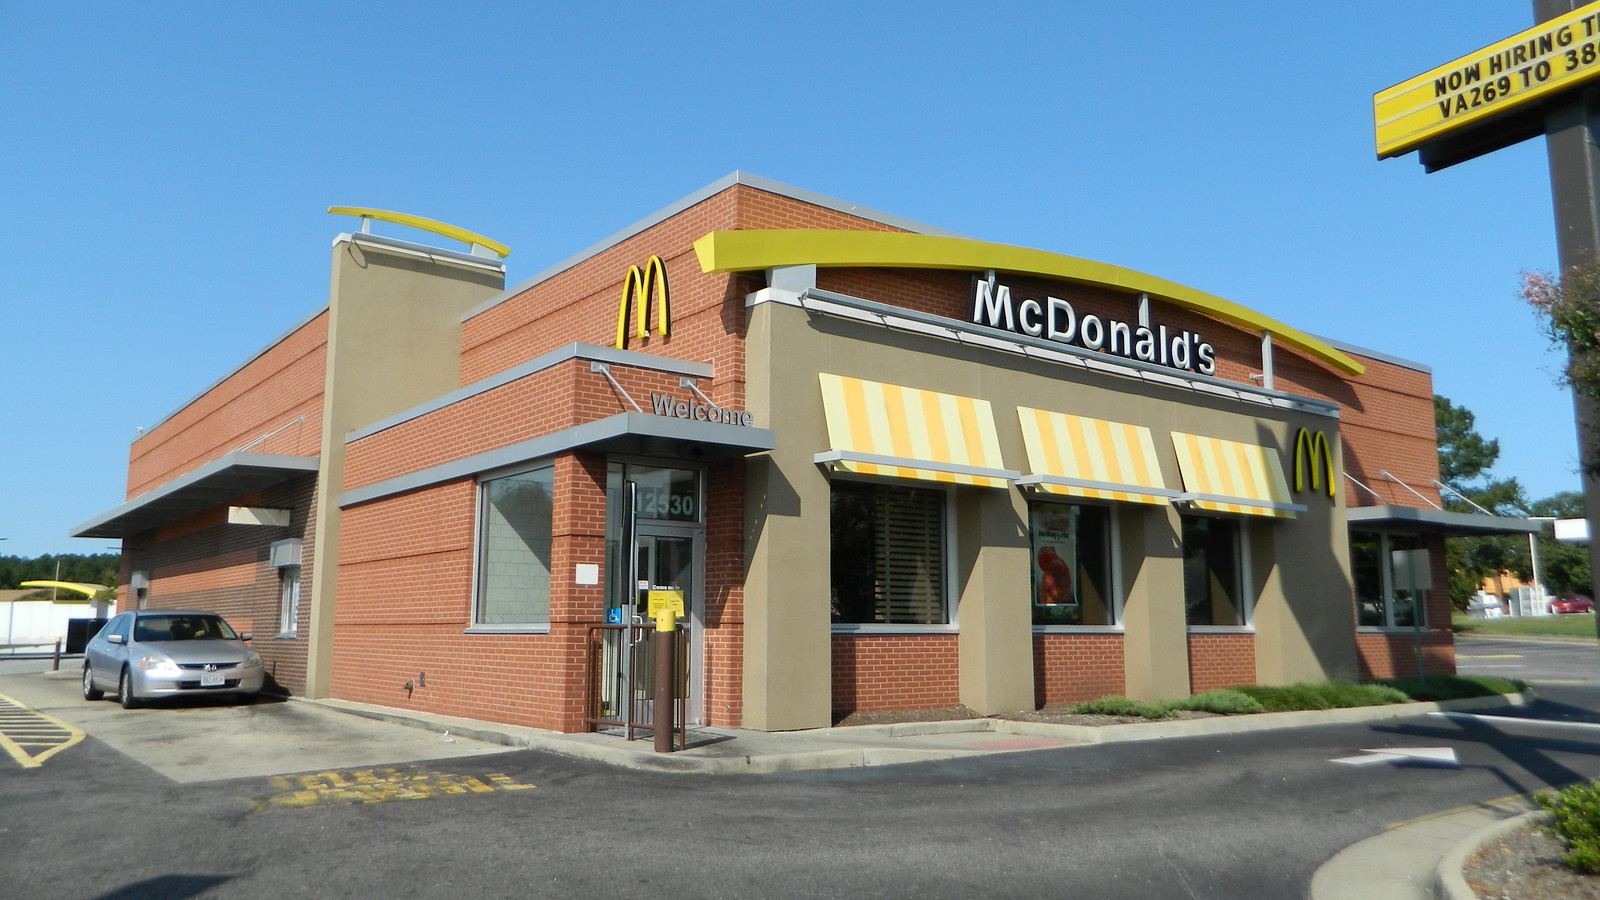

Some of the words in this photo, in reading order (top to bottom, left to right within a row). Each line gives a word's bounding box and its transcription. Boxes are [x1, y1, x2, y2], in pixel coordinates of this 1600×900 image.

[1435, 63, 1480, 97] NOW
[1489, 26, 1572, 75] HIRING
[1581, 12, 1600, 37] T
[1439, 75, 1511, 118] VA269
[1519, 61, 1551, 87] TO
[1565, 41, 1600, 72] 38
[972, 278, 1216, 376] McDonald's
[651, 393, 754, 427] Welcome
[637, 492, 694, 516] 12530
